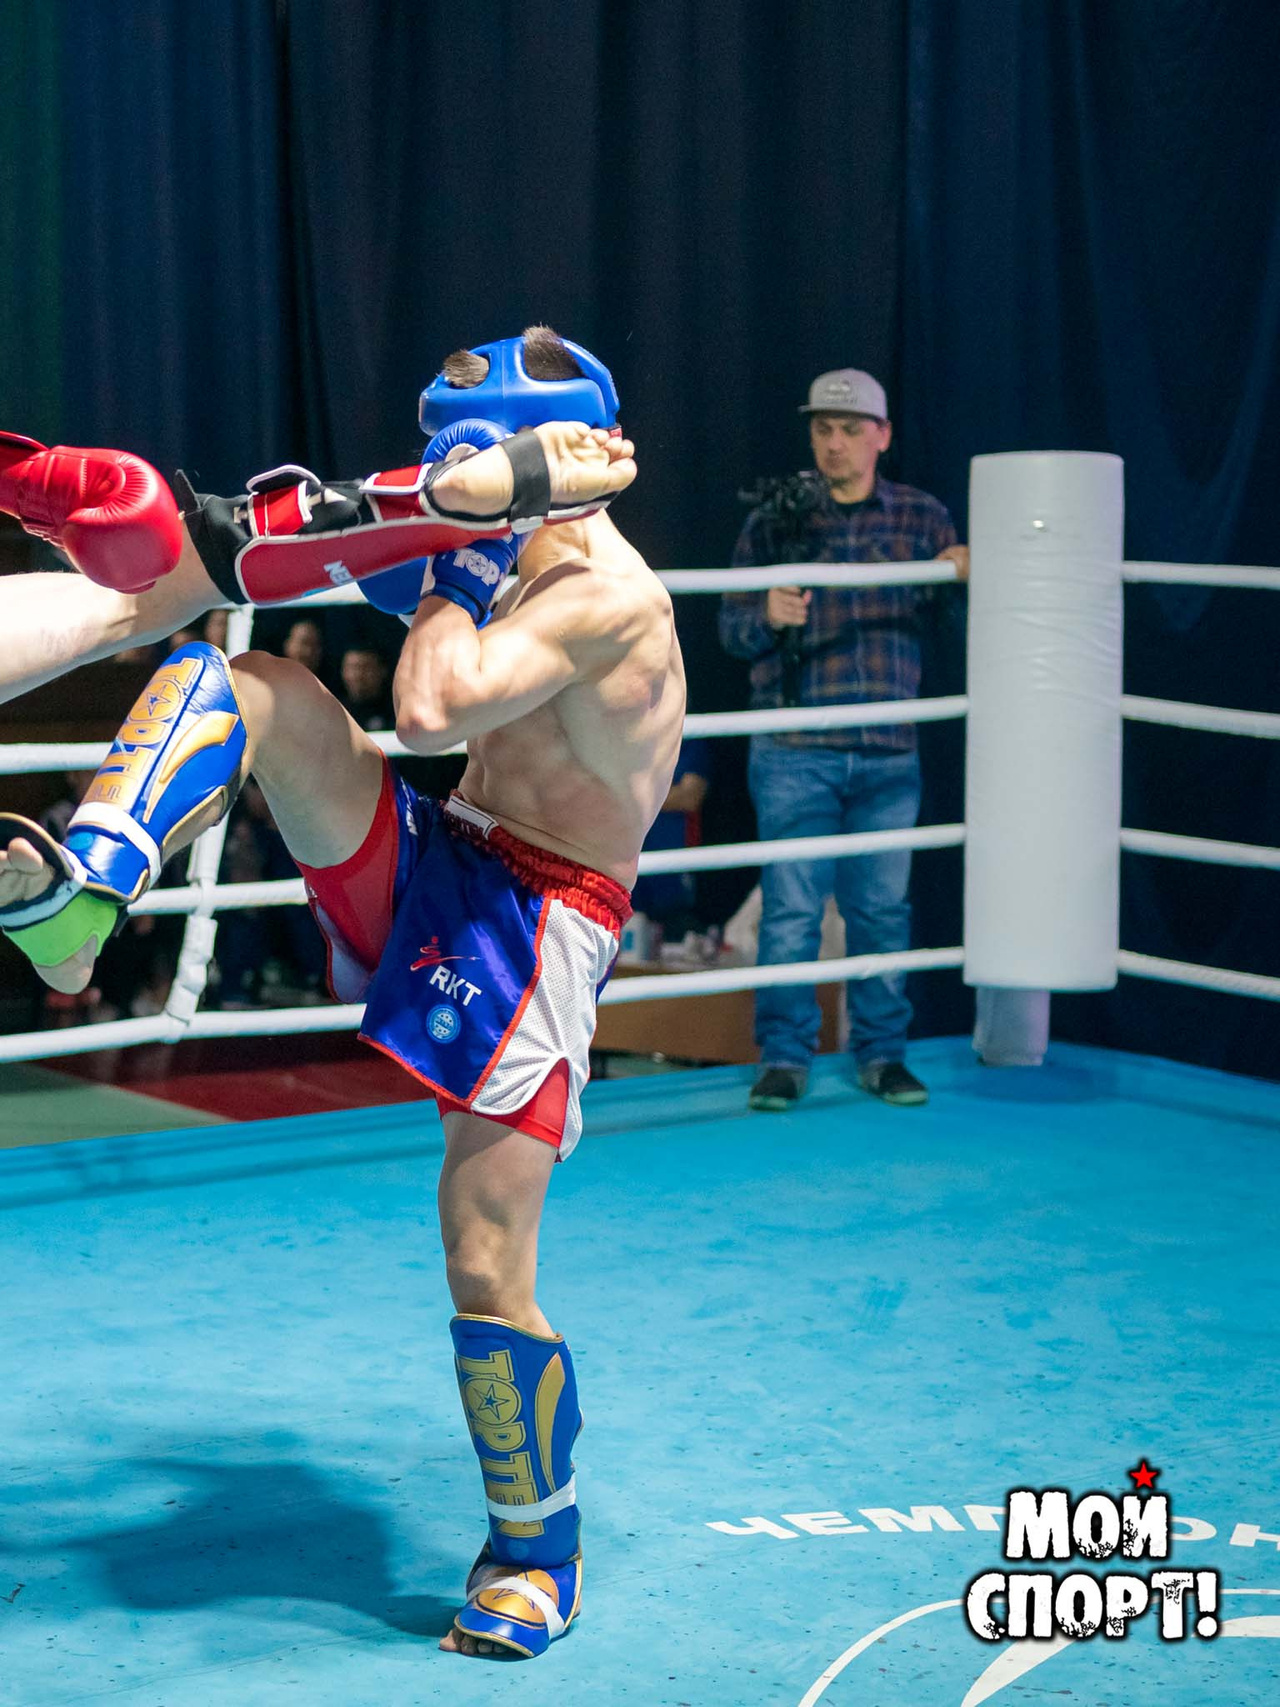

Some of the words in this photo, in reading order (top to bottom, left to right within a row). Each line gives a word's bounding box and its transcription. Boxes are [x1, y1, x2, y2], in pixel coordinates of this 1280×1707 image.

[454, 547, 501, 587] TOP
[429, 965, 482, 1007] RKT
[458, 1349, 527, 1453] TOP
